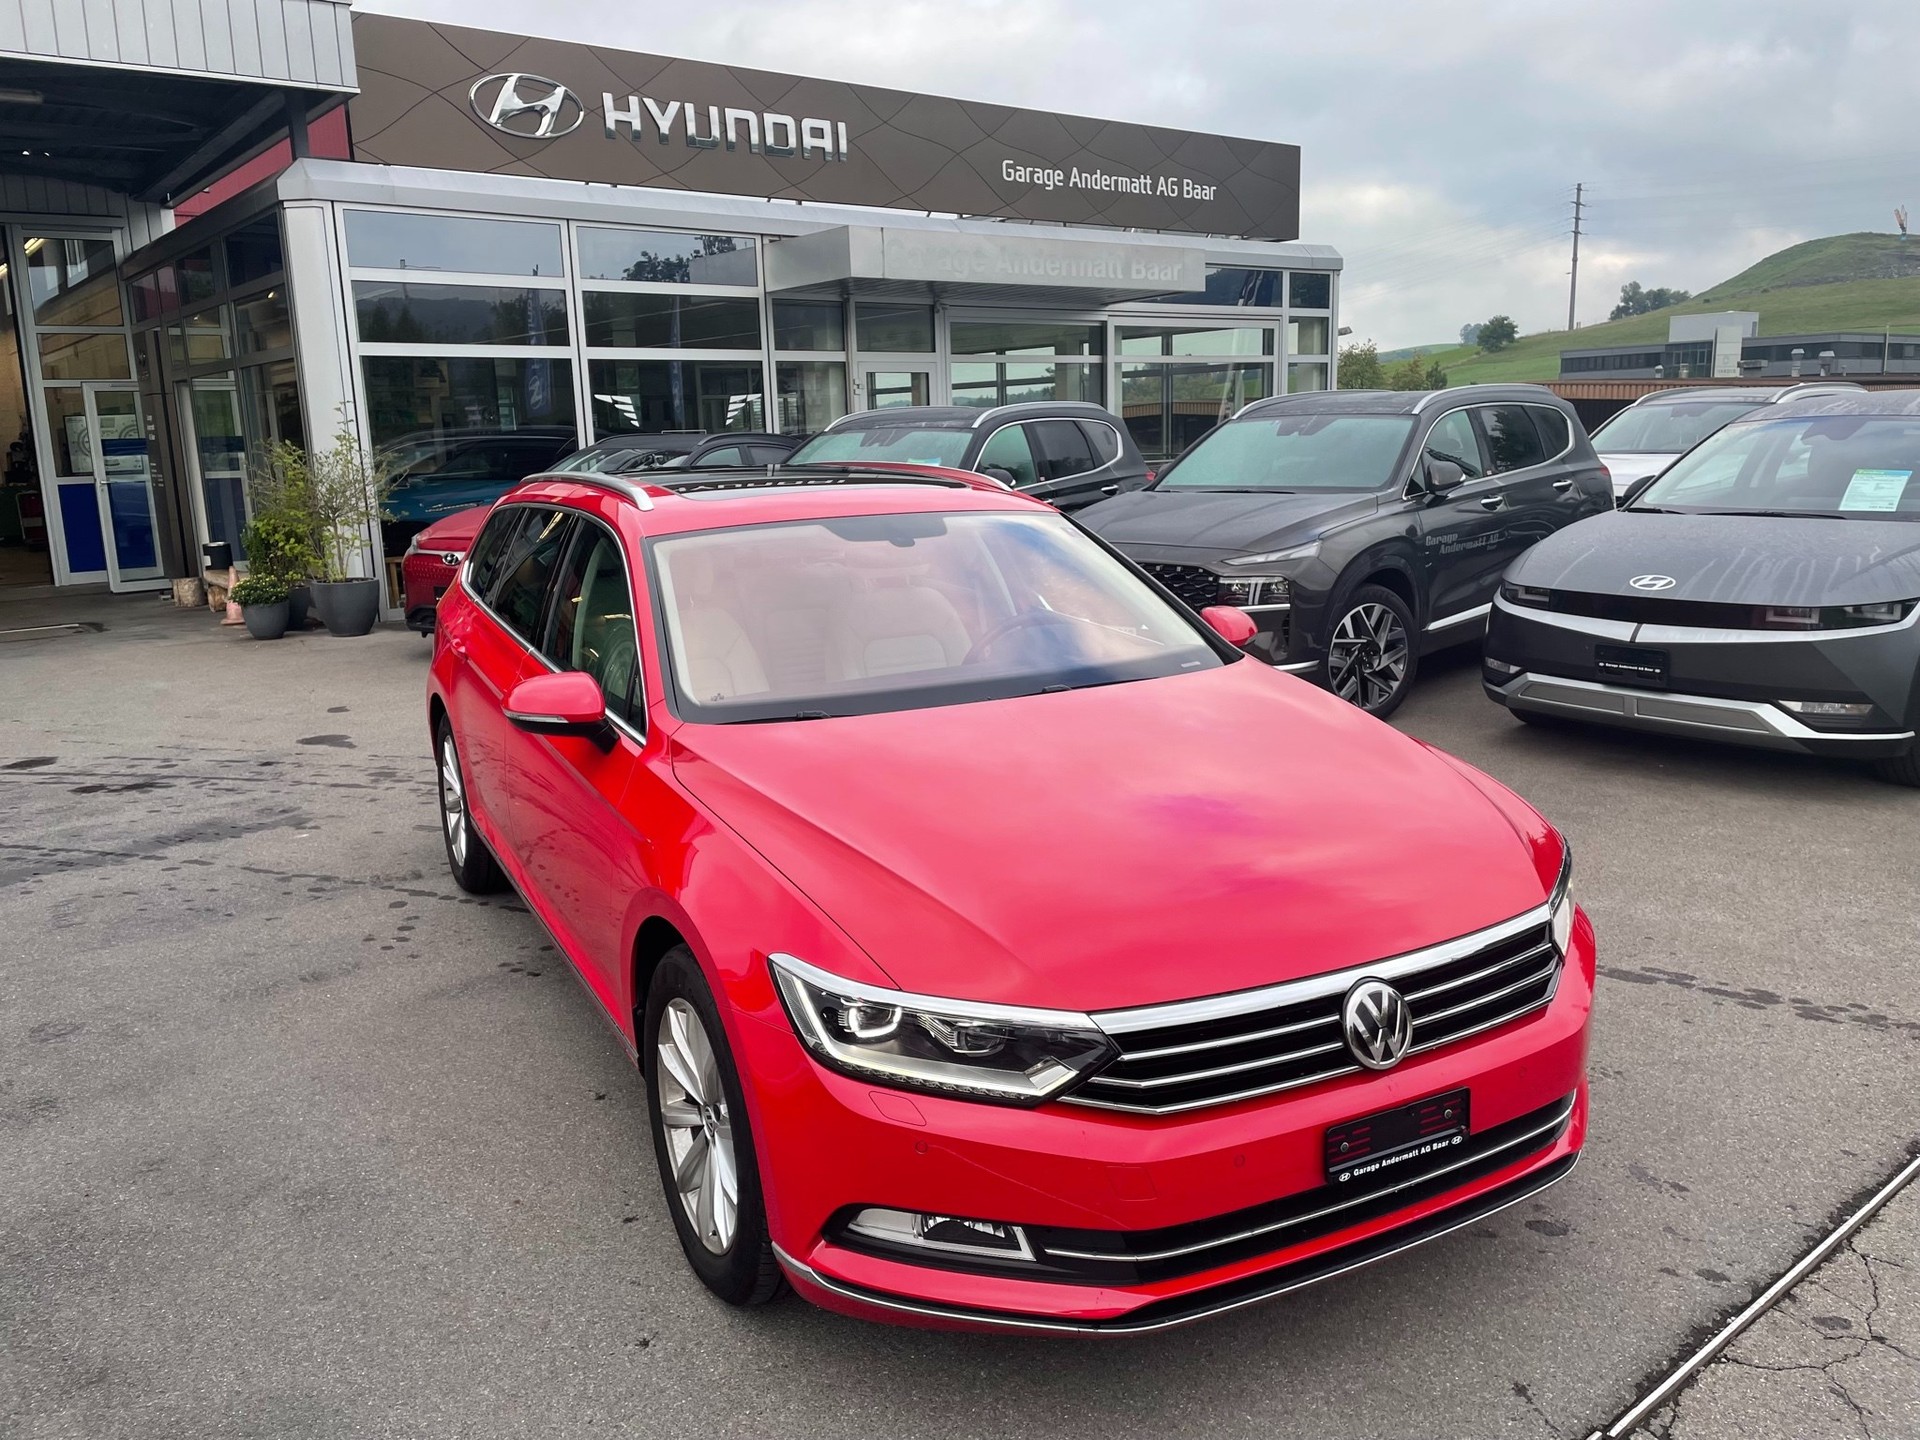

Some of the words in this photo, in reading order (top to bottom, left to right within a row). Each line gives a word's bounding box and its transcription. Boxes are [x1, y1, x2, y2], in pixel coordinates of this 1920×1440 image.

[602, 92, 847, 162] HYUNDAI
[1002, 160, 1063, 190] Garage
[1069, 167, 1152, 195] Andermatt
[1156, 176, 1178, 197] AG
[1183, 179, 1216, 200] Baar
[996, 247, 1123, 280] Andermatt
[1131, 257, 1182, 282] Baar
[1425, 533, 1458, 546] Garage
[1353, 1163, 1379, 1176] Garage
[1381, 1150, 1419, 1167] Andermatt
[1420, 1145, 1431, 1154] AG
[1432, 1140, 1449, 1150] Baar
